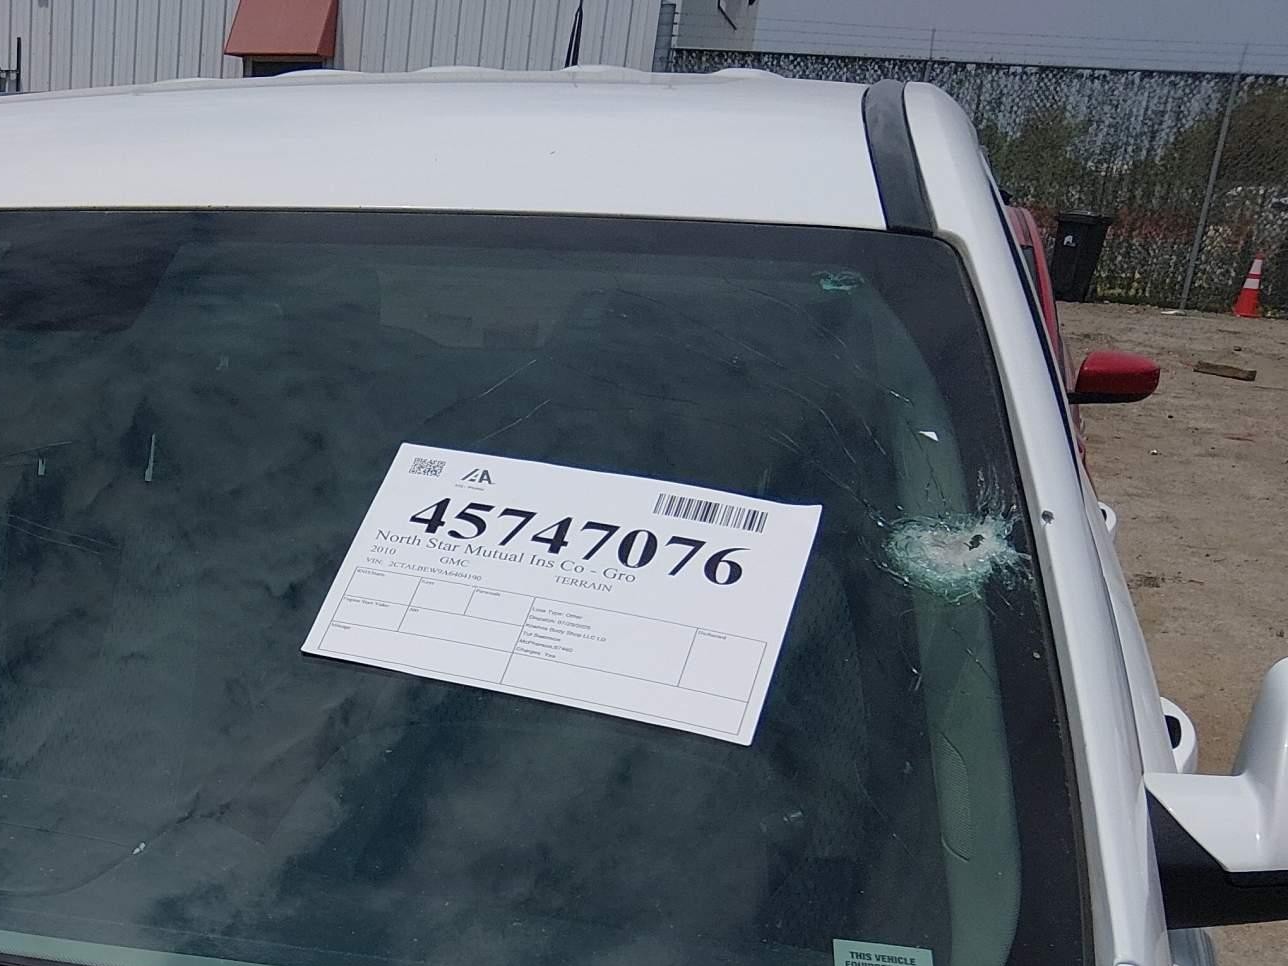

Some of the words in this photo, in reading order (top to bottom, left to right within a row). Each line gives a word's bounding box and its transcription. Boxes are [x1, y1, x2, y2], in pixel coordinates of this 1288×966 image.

[375, 529, 421, 546] North
[426, 537, 460, 552] Star
[464, 543, 523, 563] Mutual
[529, 554, 554, 569] Ins
[560, 559, 585, 574] Co
[603, 567, 636, 583] Gro
[409, 497, 750, 585] 45747076
[370, 544, 397, 556] 2010
[439, 556, 471, 568] GMC
[554, 575, 613, 593] TERRAIN
[849, 951, 872, 961] THIS
[874, 954, 916, 966] VEHICLE
